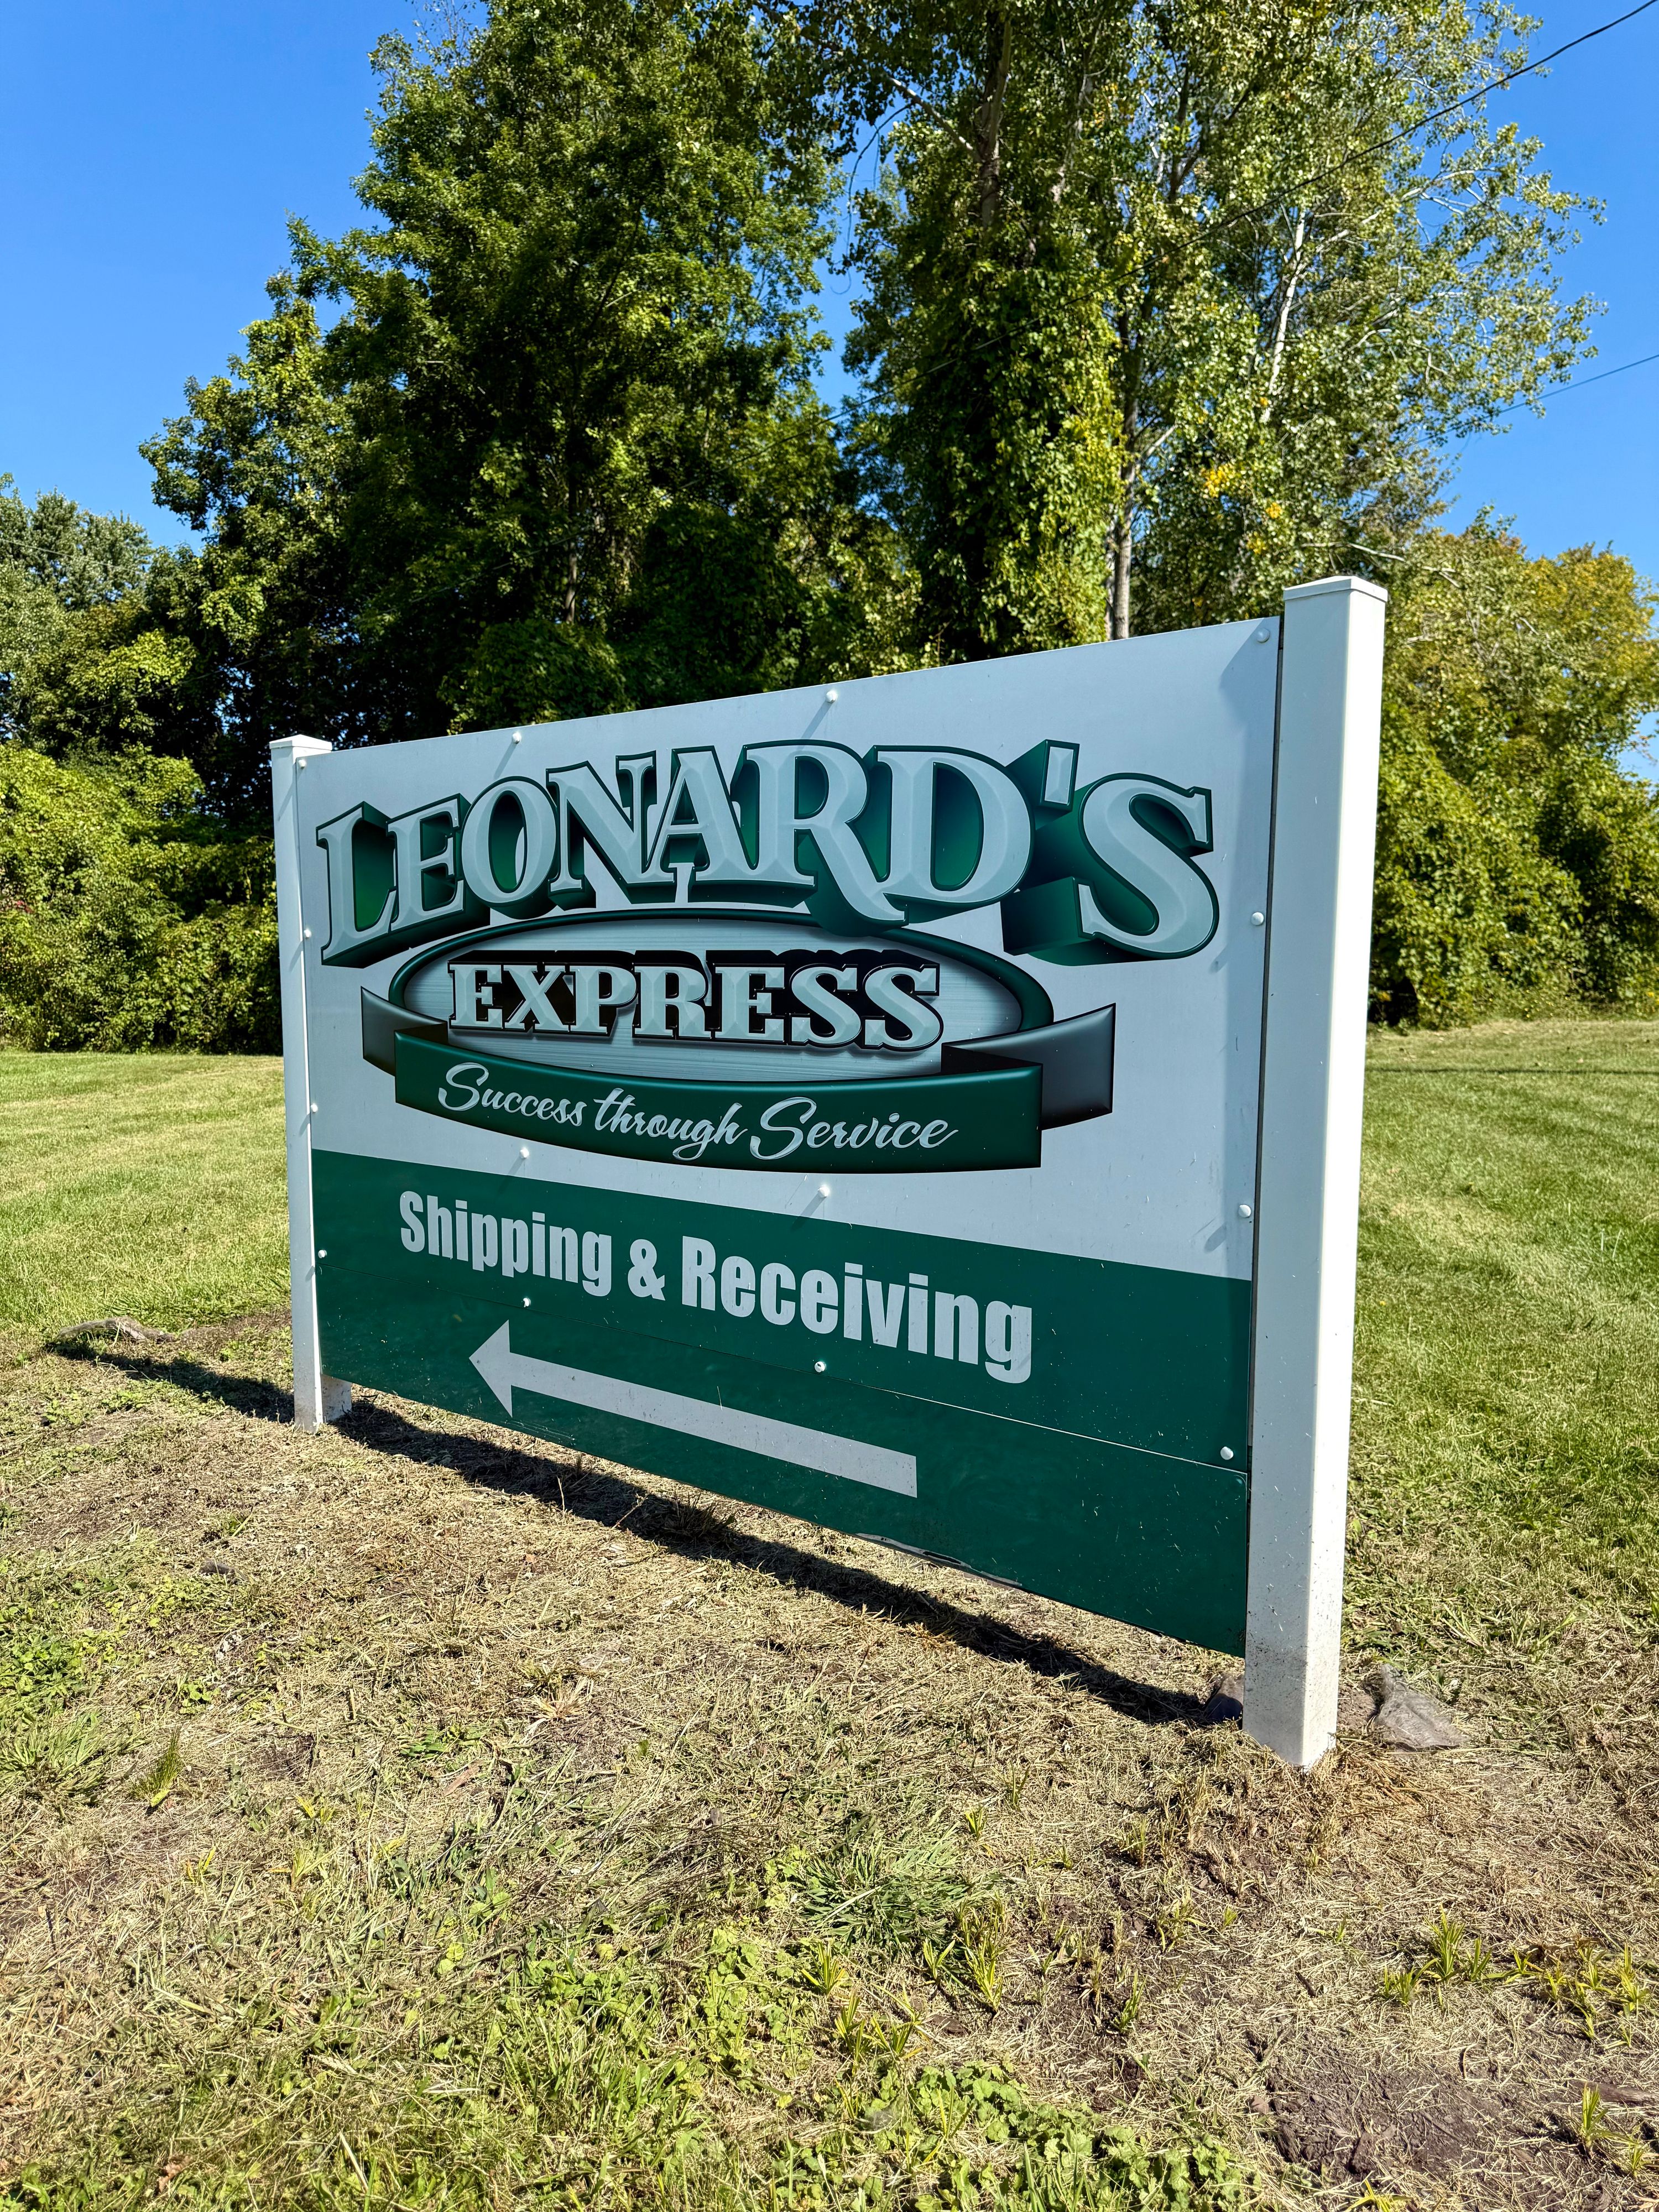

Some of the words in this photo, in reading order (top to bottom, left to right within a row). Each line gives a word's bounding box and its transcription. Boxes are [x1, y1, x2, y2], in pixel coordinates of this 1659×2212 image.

[316, 739, 1220, 967] LEONARD'S
[447, 952, 944, 1053] EXPRESS
[438, 1062, 587, 1127] Success
[593, 1087, 749, 1161] through
[750, 1097, 959, 1160] Service
[399, 1191, 612, 1297] Shipping
[628, 1239, 666, 1301] &
[682, 1235, 1032, 1384] Receiving
